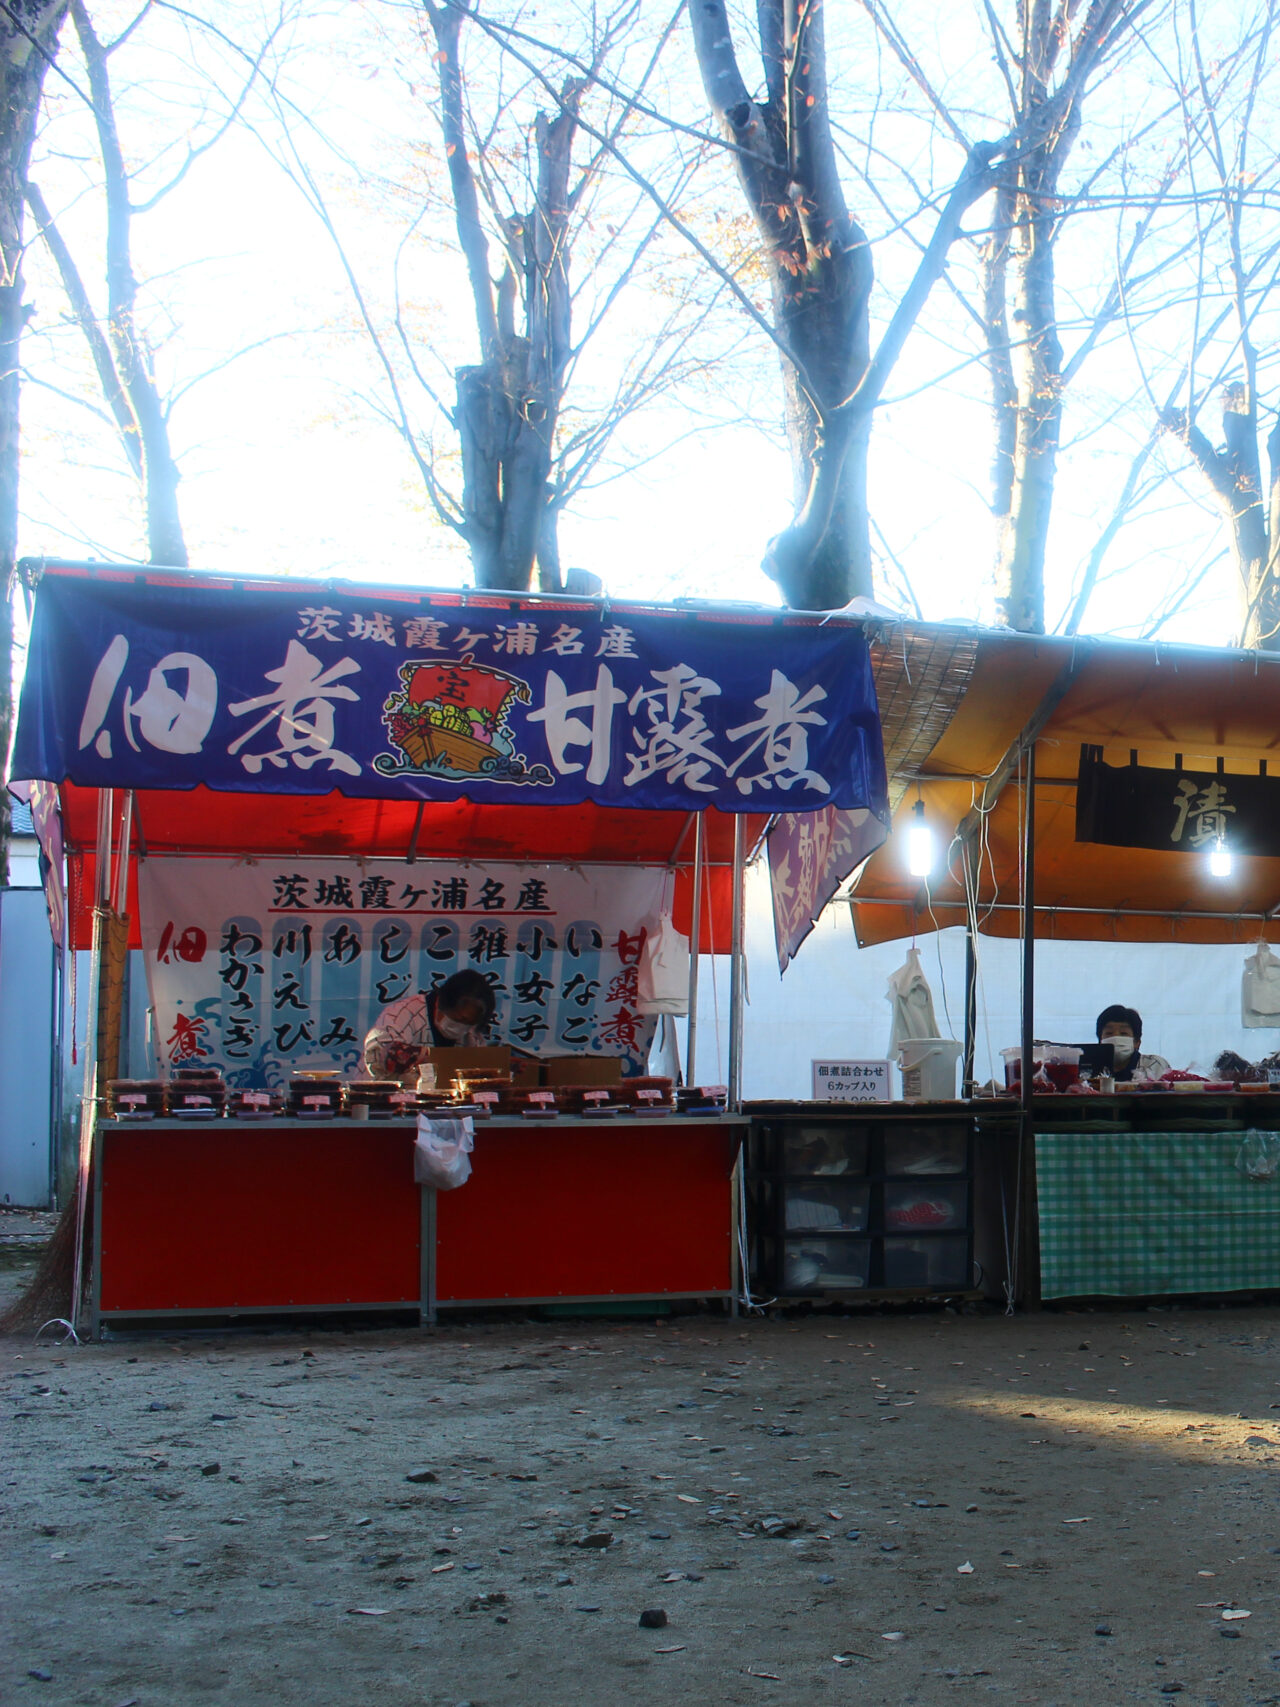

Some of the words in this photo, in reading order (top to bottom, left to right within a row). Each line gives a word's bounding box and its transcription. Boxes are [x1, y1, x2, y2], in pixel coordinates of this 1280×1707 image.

[79, 634, 363, 777] 佃煮
[527, 662, 830, 798] 甘露煮
[157, 921, 208, 1064] 佃煮
[218, 924, 264, 1057] わかさぎ
[273, 925, 315, 1052] 川えび
[319, 925, 362, 1047] あみ
[376, 926, 413, 1004] しじ
[509, 926, 558, 1042] 小女子
[561, 927, 603, 1044] いなご
[600, 926, 648, 1052] 甘露煮
[818, 1065, 884, 1077] 佃煮詰合わせ
[828, 1081, 876, 1092] 6カップ入り
